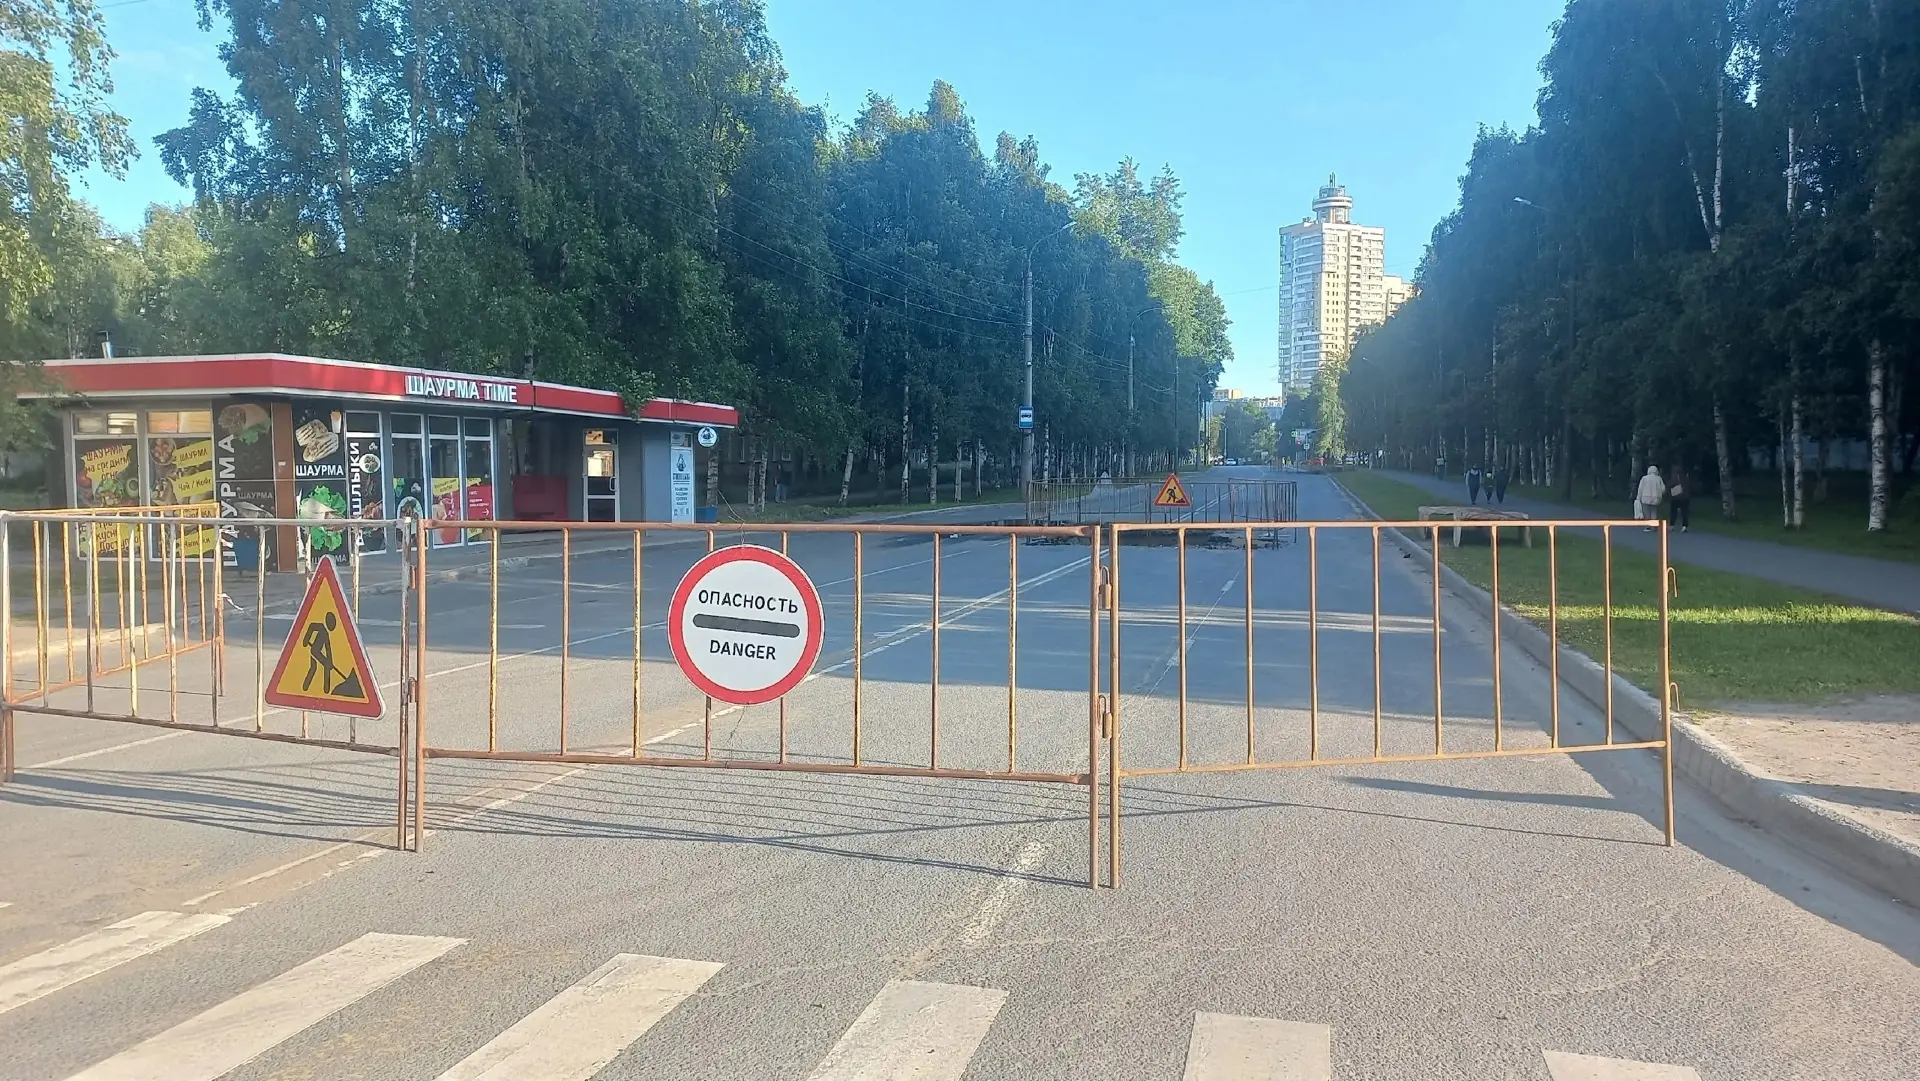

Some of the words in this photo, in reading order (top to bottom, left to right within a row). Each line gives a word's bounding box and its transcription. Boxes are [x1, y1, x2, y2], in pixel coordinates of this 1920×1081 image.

[406, 375, 480, 401] ШАУРМА
[481, 381, 517, 403] TIME
[86, 443, 124, 461] ШАУРМА
[179, 448, 208, 462] ШАУРМА
[295, 464, 344, 477] ШАУРМА
[218, 435, 239, 567] ШАУРМА
[238, 491, 273, 499] ШАУРМА
[349, 442, 364, 546] ШЛЫКИ
[312, 554, 347, 564] ШМА
[698, 589, 799, 614] ОПАСНОСТЬ
[709, 639, 776, 660] DANGER
